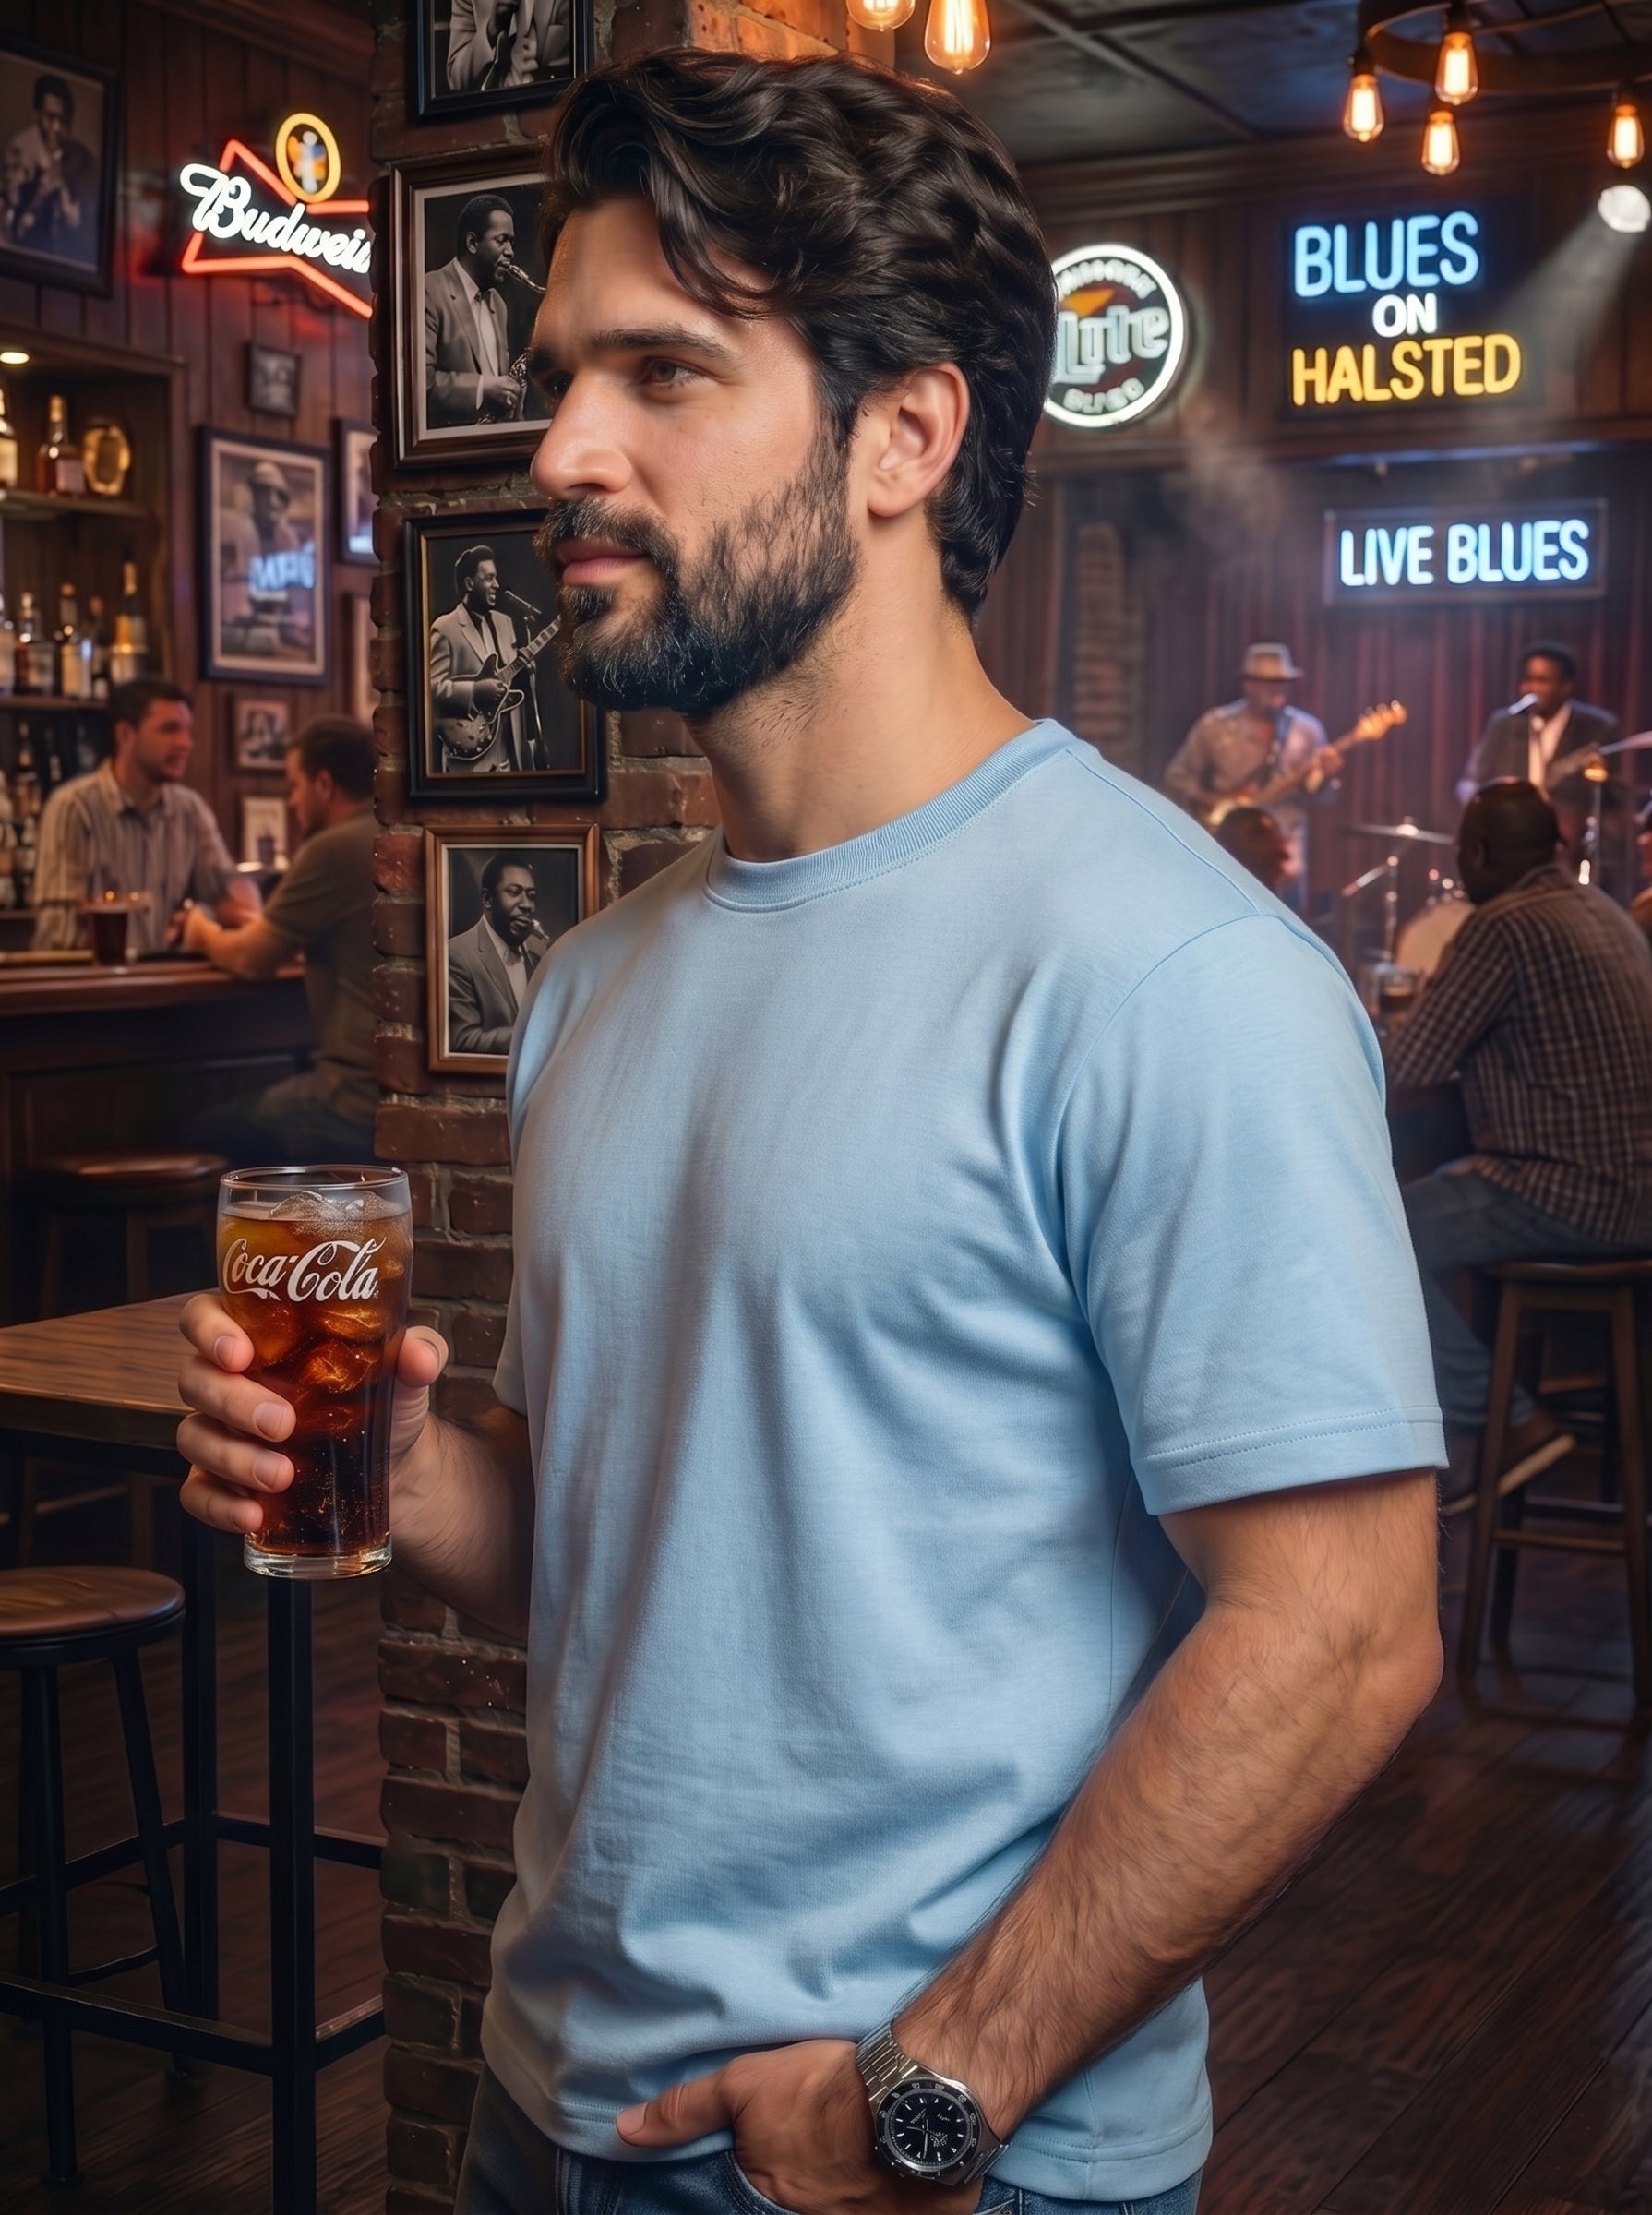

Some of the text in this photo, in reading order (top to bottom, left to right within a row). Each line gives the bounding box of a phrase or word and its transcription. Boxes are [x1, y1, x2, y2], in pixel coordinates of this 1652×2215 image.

[1294, 210, 1479, 298] BLUES
[1371, 292, 1438, 338] ON
[1291, 333, 1522, 406] HALSTED
[1340, 519, 1590, 587] LIVE BLUES
[222, 1236, 386, 1302] Coca-Cola
